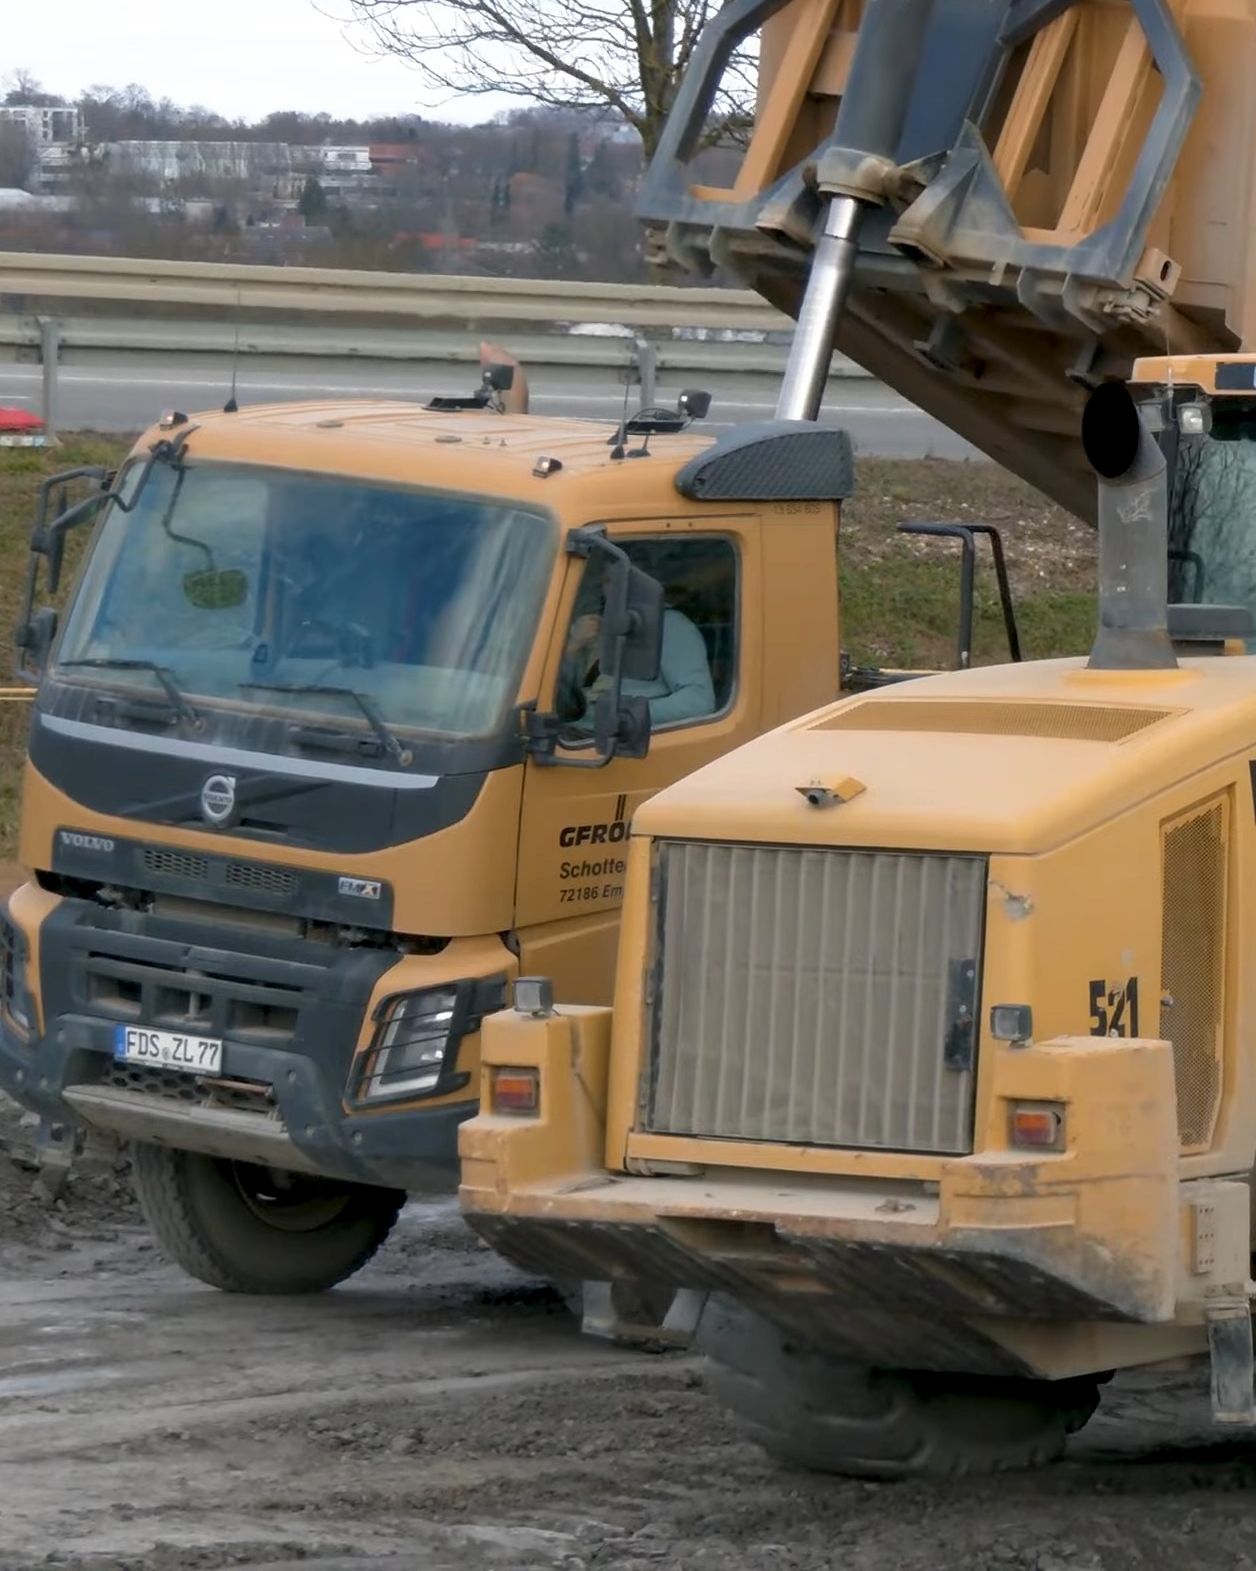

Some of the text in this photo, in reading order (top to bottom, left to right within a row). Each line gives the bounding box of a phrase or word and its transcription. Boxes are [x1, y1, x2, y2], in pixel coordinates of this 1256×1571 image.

[60, 831, 114, 851] VOLVO
[560, 886, 599, 902] 72186
[1089, 976, 1138, 1038] 521
[126, 1031, 160, 1057] FDS
[198, 1041, 219, 1066] 77
